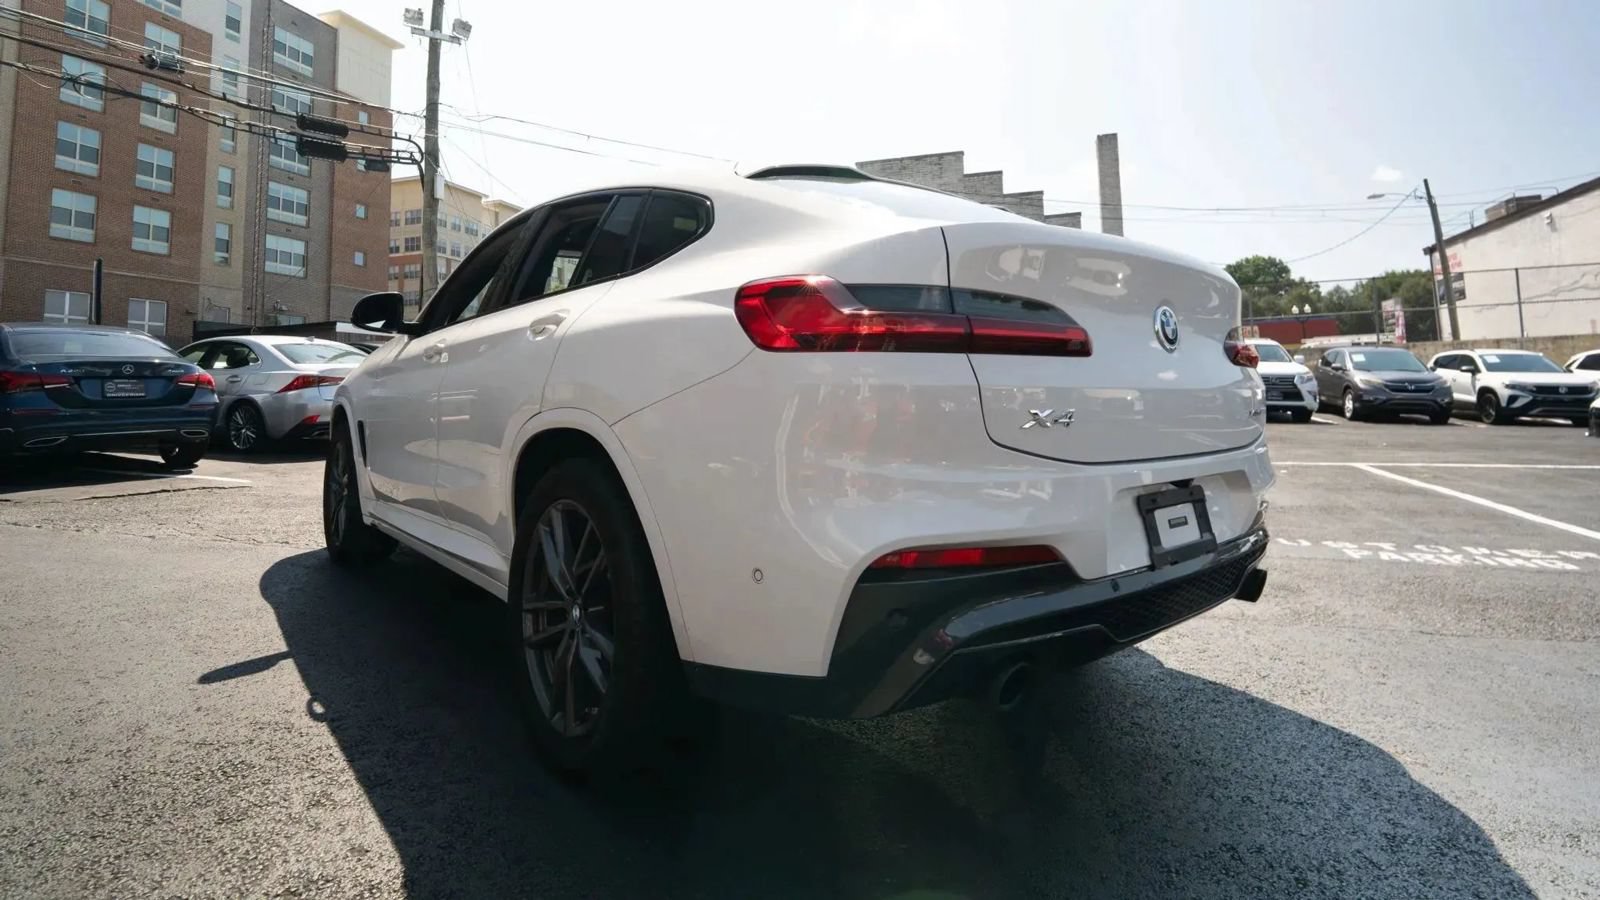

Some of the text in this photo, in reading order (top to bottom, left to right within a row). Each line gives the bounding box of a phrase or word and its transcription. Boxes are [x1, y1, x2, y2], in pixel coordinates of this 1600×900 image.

[1021, 408, 1075, 429] X4
[1275, 537, 1600, 560] USTOMER
[1341, 548, 1580, 570] PARKING
